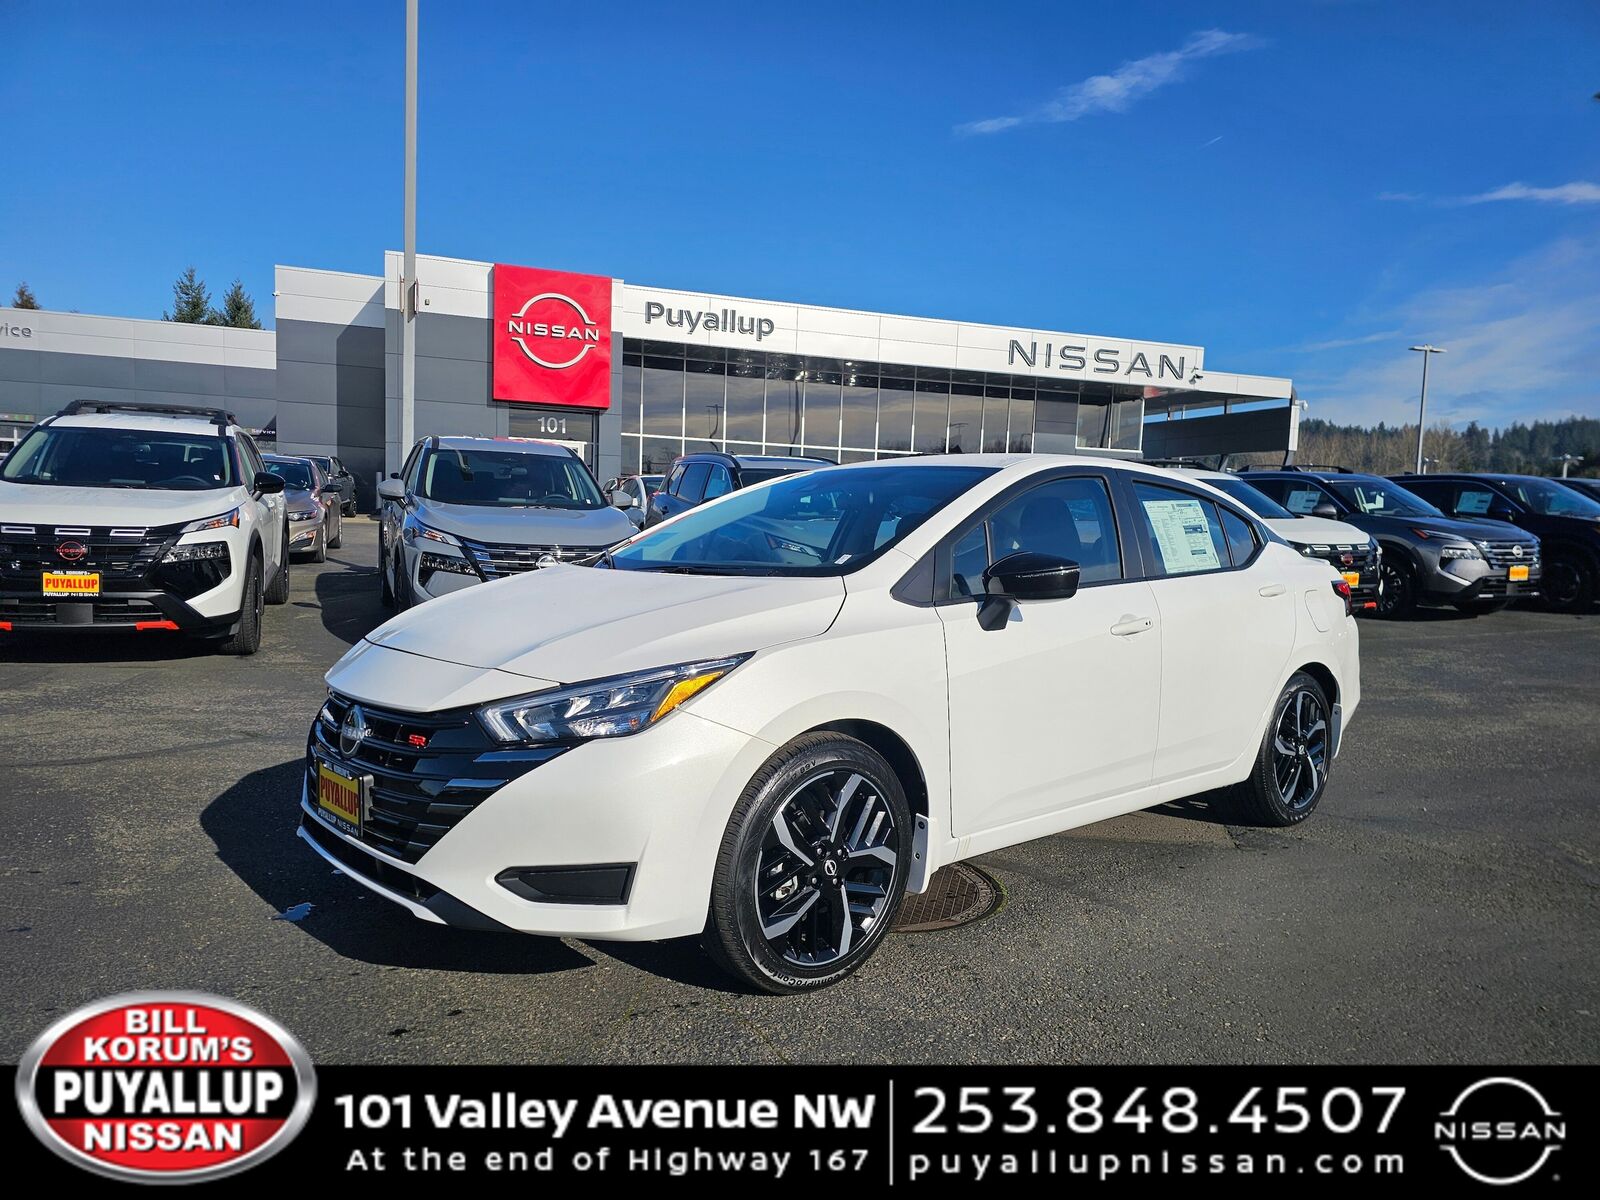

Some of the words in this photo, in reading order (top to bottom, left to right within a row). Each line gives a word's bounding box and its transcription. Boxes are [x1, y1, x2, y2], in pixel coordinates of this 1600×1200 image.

[508, 320, 600, 341] NISSAN
[645, 301, 775, 341] Puyallup
[1008, 339, 1185, 380] NISSAN
[538, 416, 567, 434] 101
[45, 578, 97, 589] PUYALLUP
[320, 775, 359, 816] PUYALLUP
